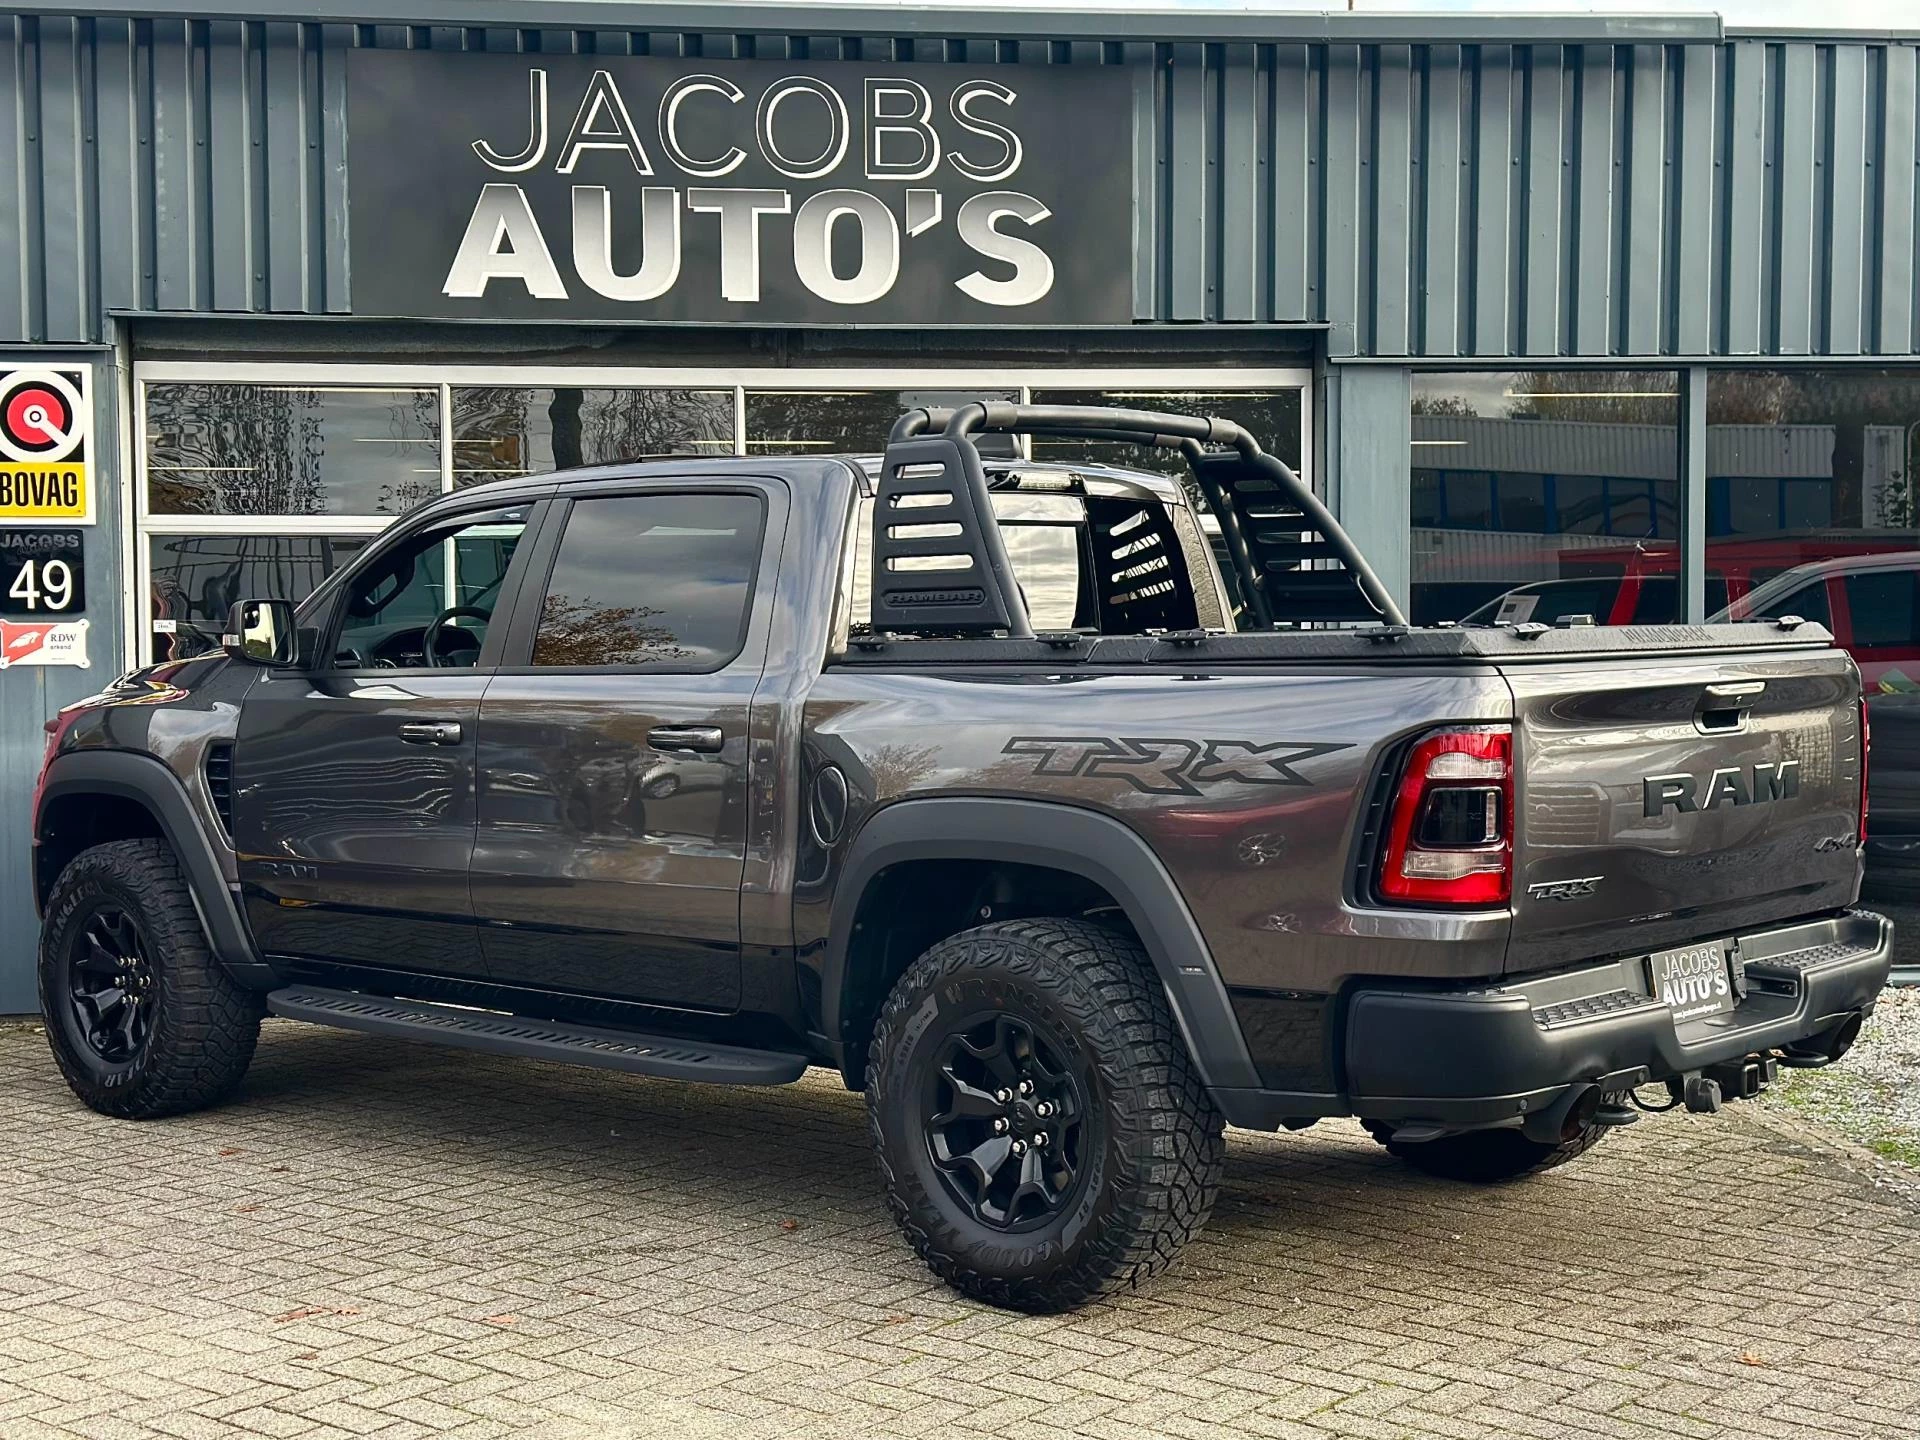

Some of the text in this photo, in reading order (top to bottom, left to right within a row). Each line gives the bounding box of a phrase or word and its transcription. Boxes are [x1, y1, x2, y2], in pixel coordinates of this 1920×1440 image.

[472, 68, 1023, 182] JACOBS
[441, 183, 1055, 306] AUTO'S
[0, 471, 77, 507] BOVAG
[0, 534, 79, 548] JACOBS
[9, 559, 72, 610] 49
[890, 590, 979, 604] RAMBAR
[50, 633, 76, 642] RDW
[1000, 736, 1358, 796] TRX
[1643, 760, 1799, 818] RAM
[1527, 876, 1604, 900] TRX
[1661, 946, 1721, 980] JACOBS
[1663, 969, 1728, 1006] AUTO'S
